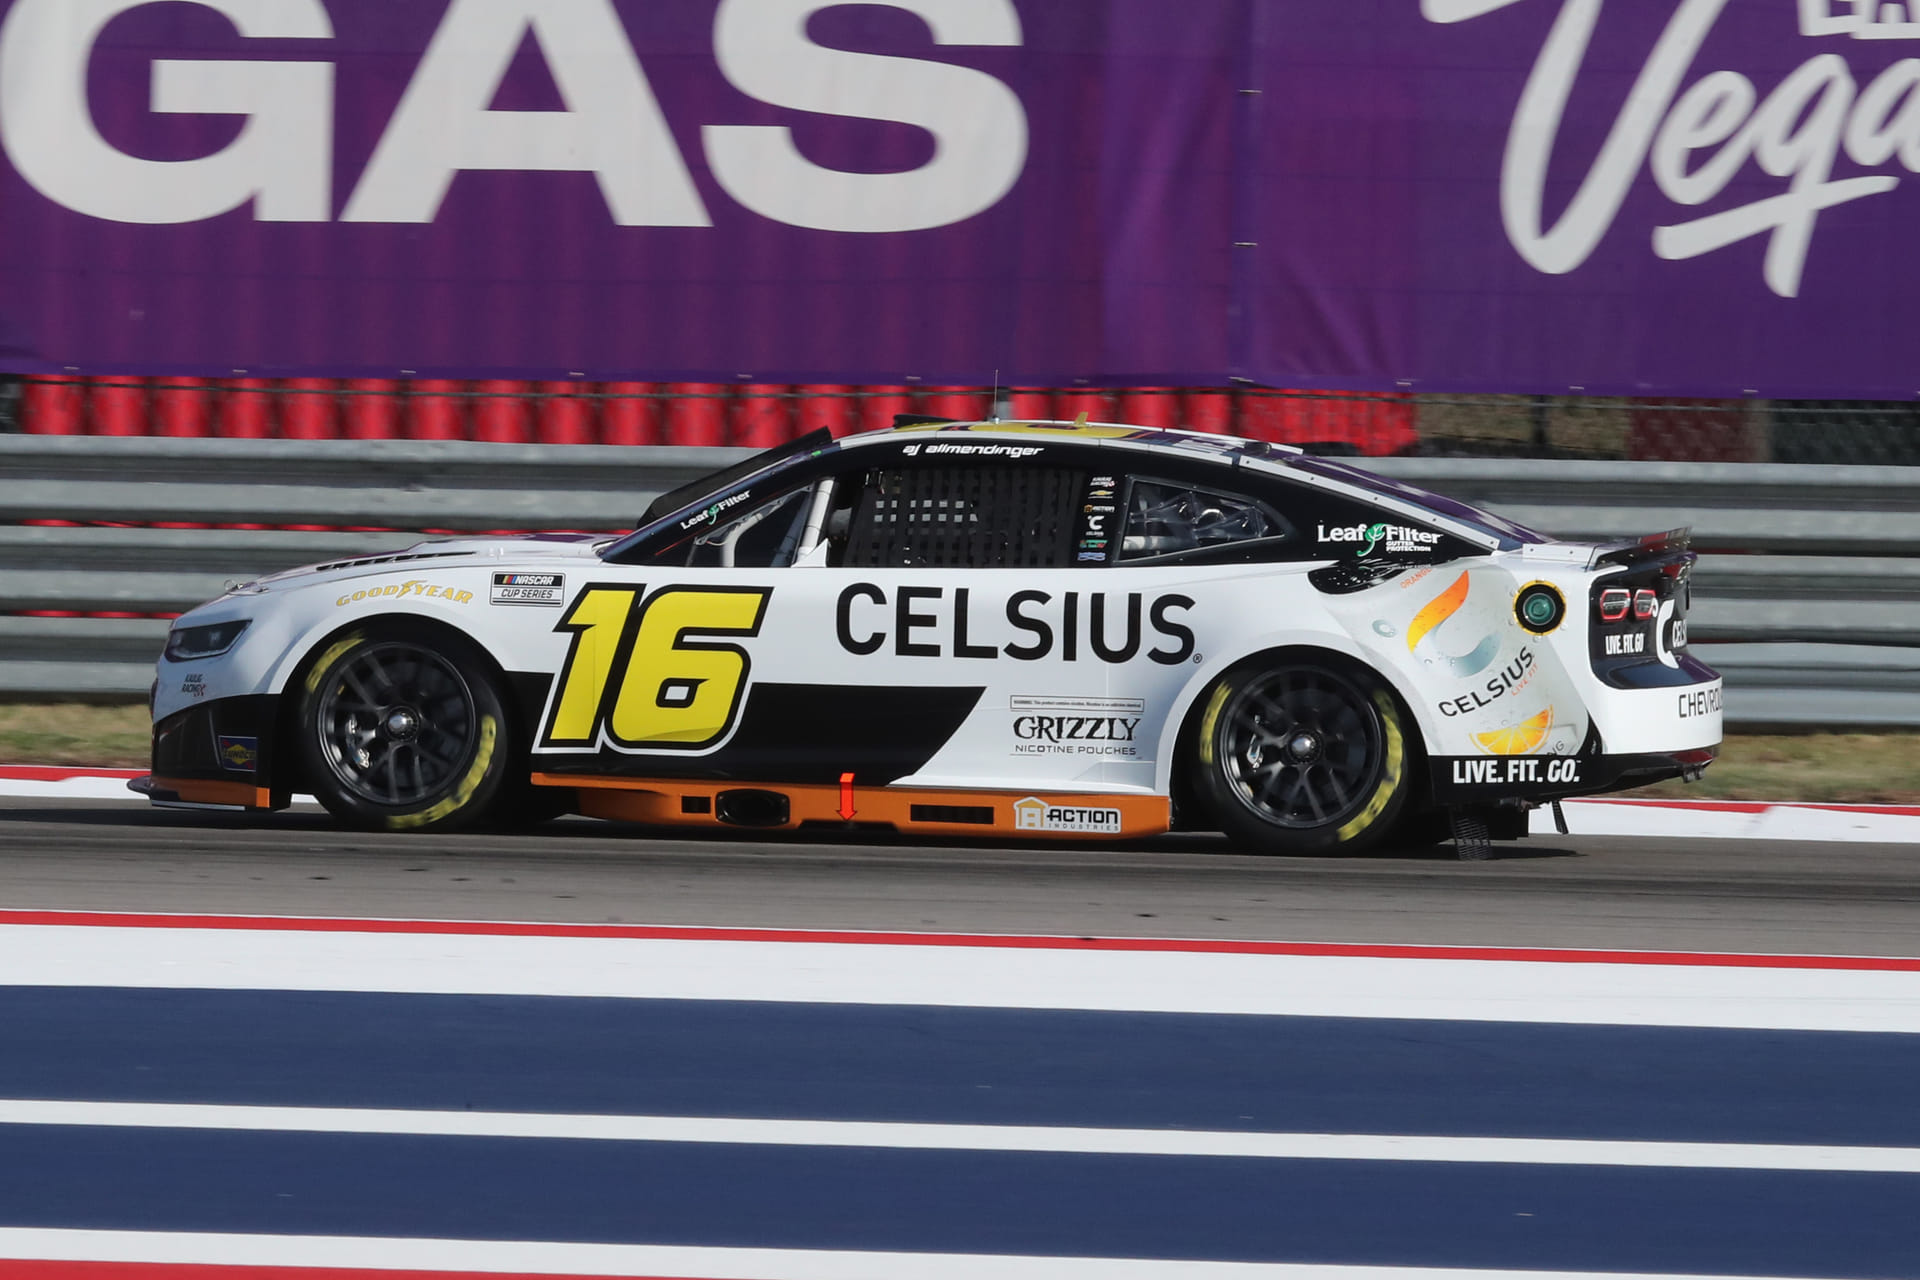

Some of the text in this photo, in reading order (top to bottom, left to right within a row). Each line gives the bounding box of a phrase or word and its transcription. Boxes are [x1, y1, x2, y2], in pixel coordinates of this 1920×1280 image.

[0, 0, 1028, 232] GAS
[902, 443, 1044, 458] aj allmendinger
[515, 575, 554, 585] NASCAR
[336, 580, 473, 607] GOODYEAR
[501, 588, 554, 599] CUP SERIES
[835, 582, 1196, 666] CELSIUS
[533, 582, 775, 756] 16
[1438, 646, 1534, 717] CELSIUS
[1013, 716, 1141, 744] GRIZZLY
[1015, 744, 1137, 756] NICOTINE POUCHES
[1453, 760, 1503, 784] LIVE.
[1507, 759, 1543, 783] FIT.
[1048, 823, 1119, 832] INDUSTRIES
